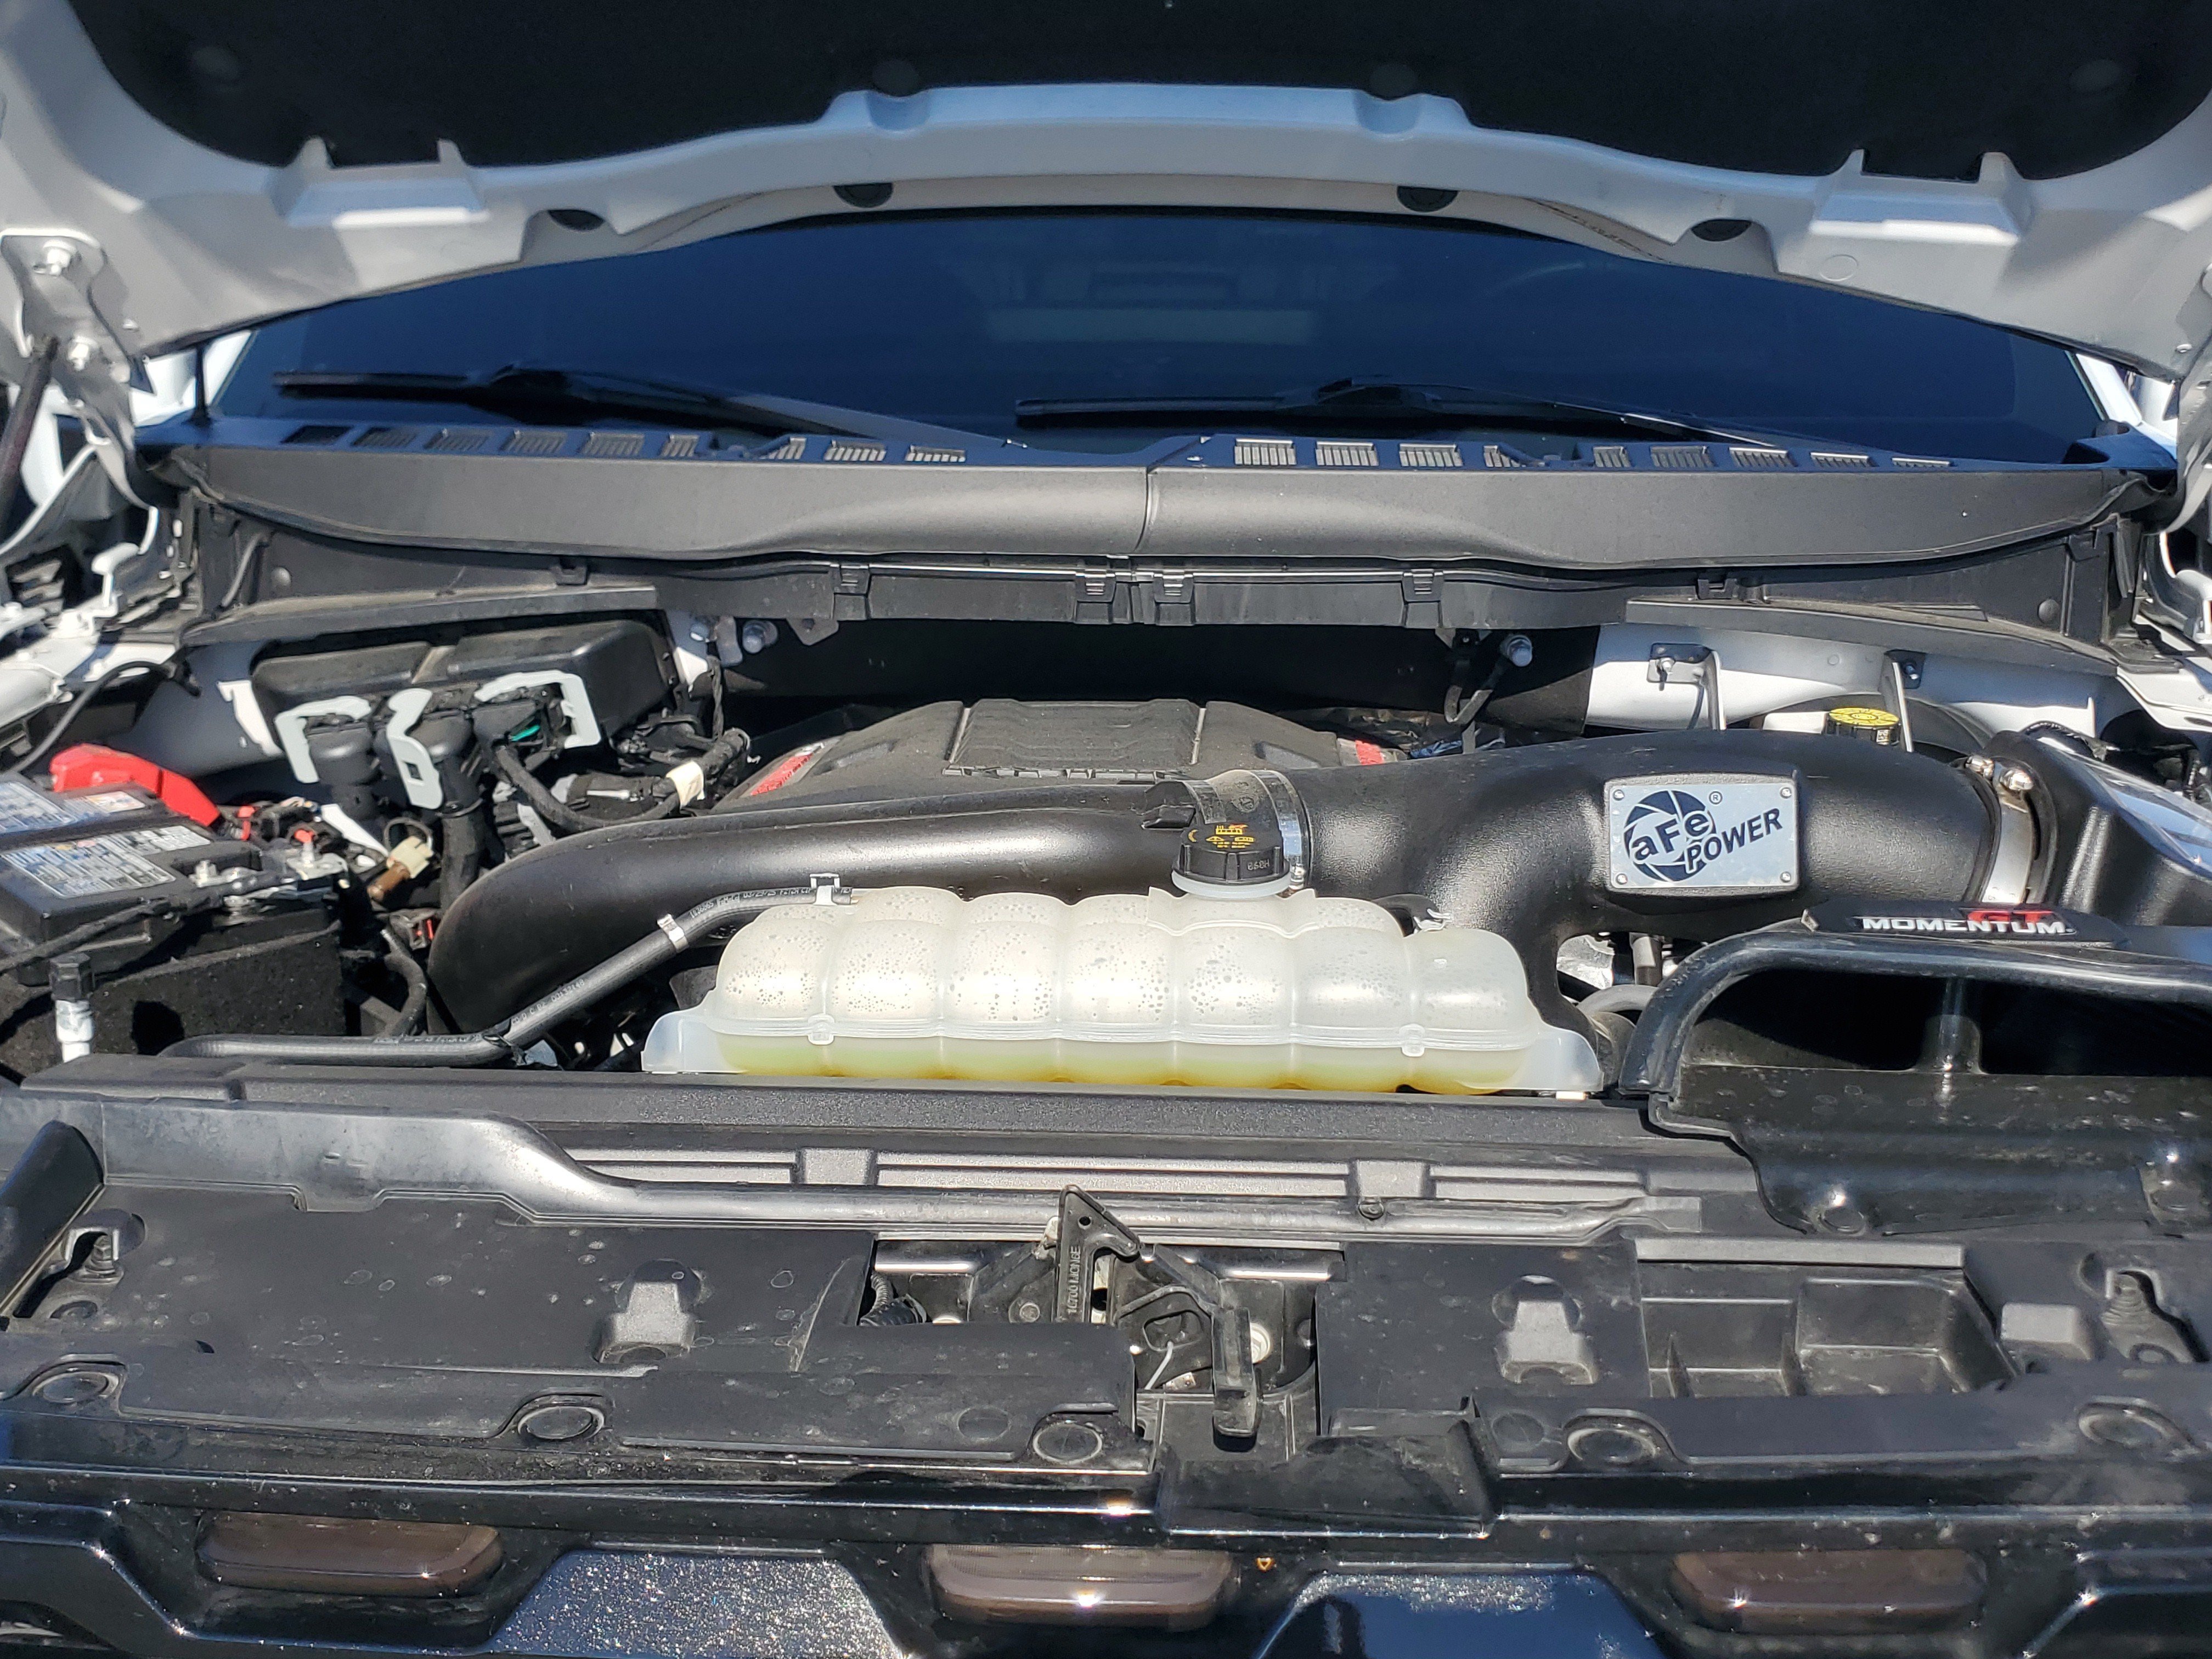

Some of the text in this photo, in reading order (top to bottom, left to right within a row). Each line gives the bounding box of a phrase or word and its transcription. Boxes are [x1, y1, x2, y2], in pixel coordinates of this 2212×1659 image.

[1632, 812, 1710, 861] aFe
[1686, 808, 1783, 871] POWER
[1863, 917, 2065, 934] MOMENTUM
